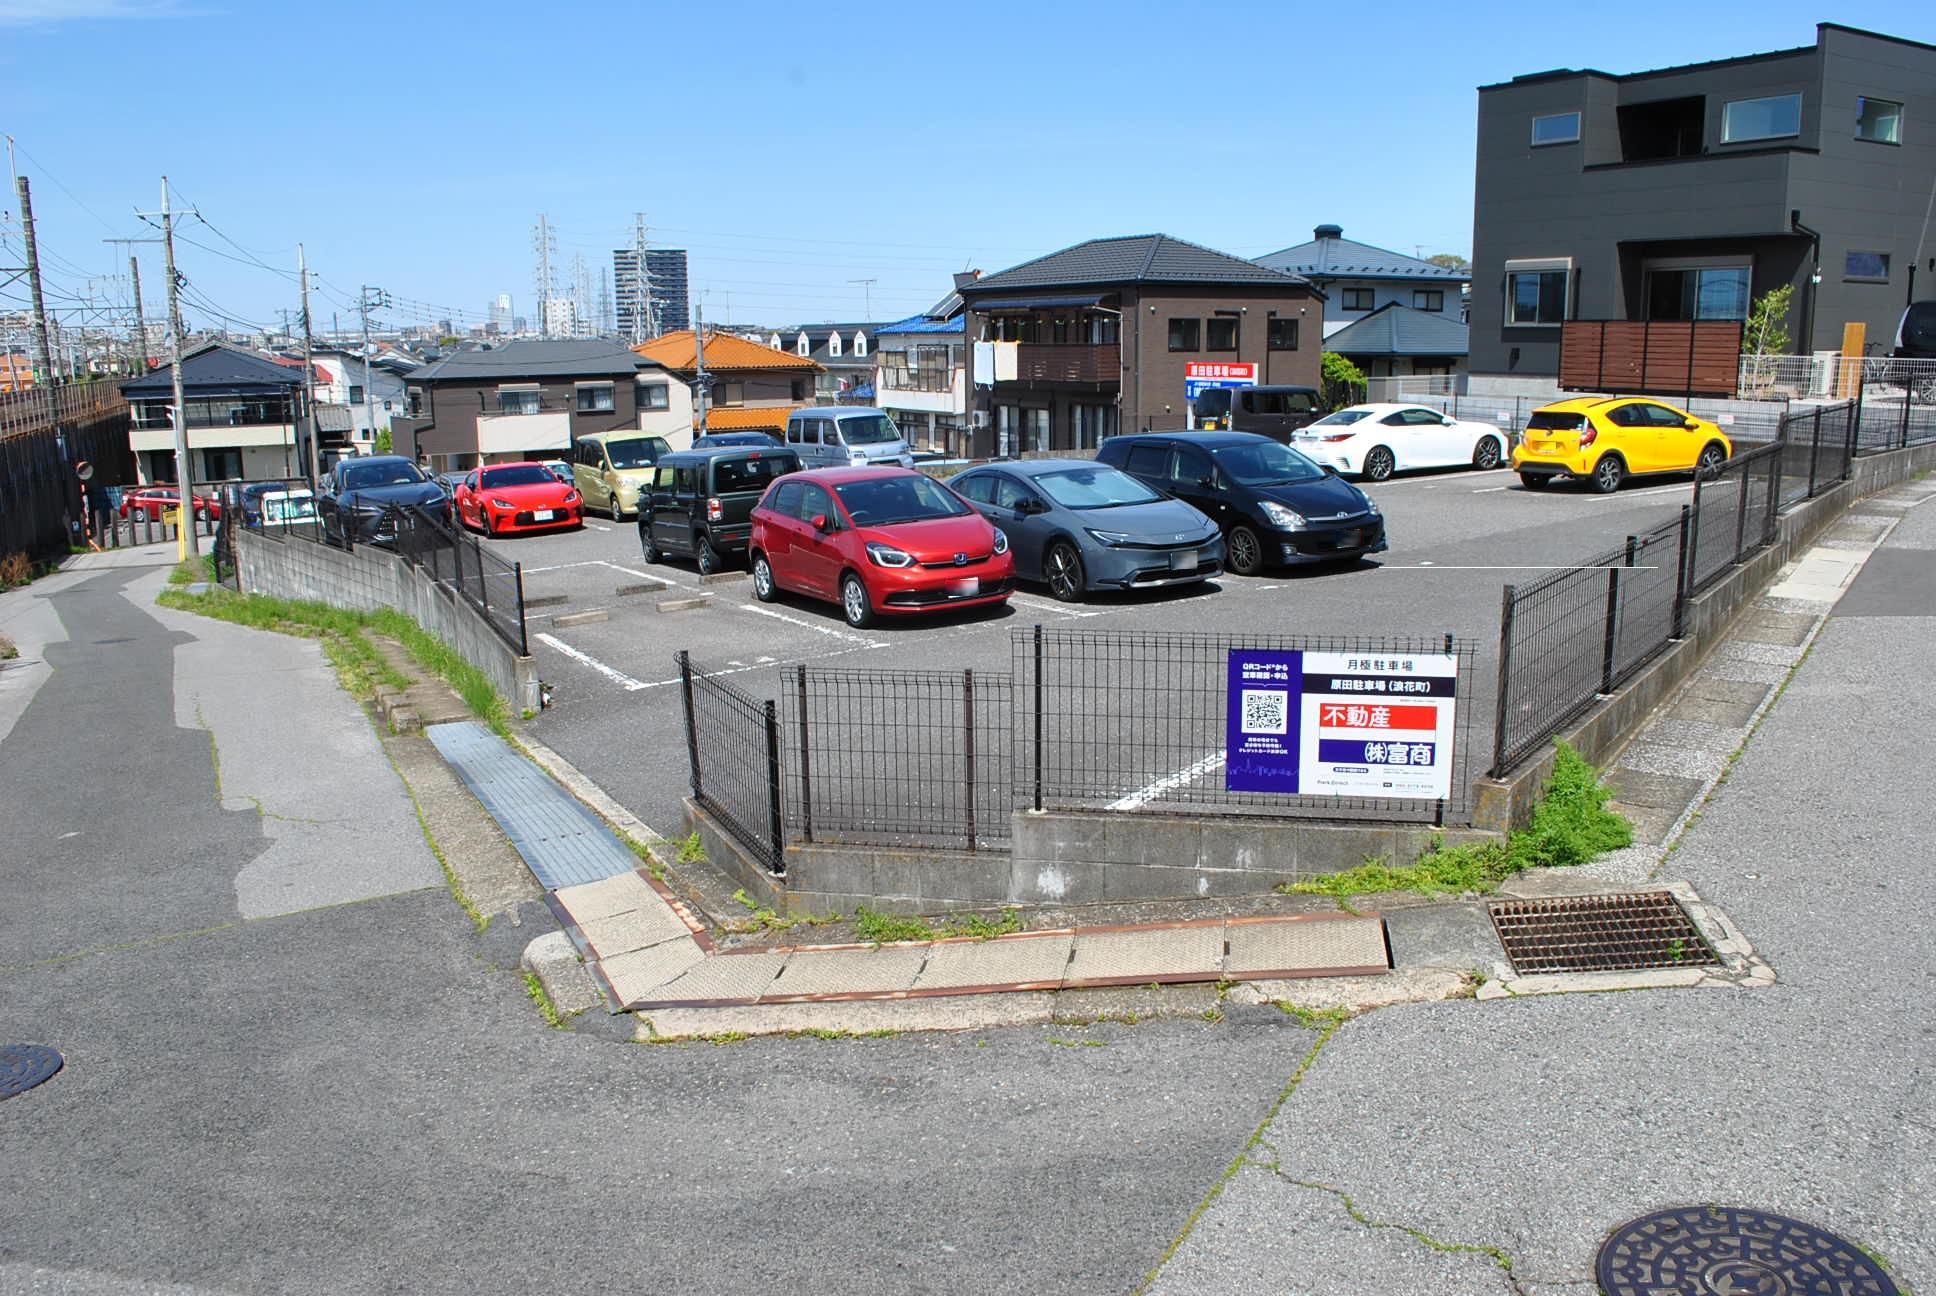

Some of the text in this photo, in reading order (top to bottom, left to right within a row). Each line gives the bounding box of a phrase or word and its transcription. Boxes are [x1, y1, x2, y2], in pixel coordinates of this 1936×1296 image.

[1347, 659, 1413, 672] 月極駐車場
[1323, 705, 1391, 728] 不動産
